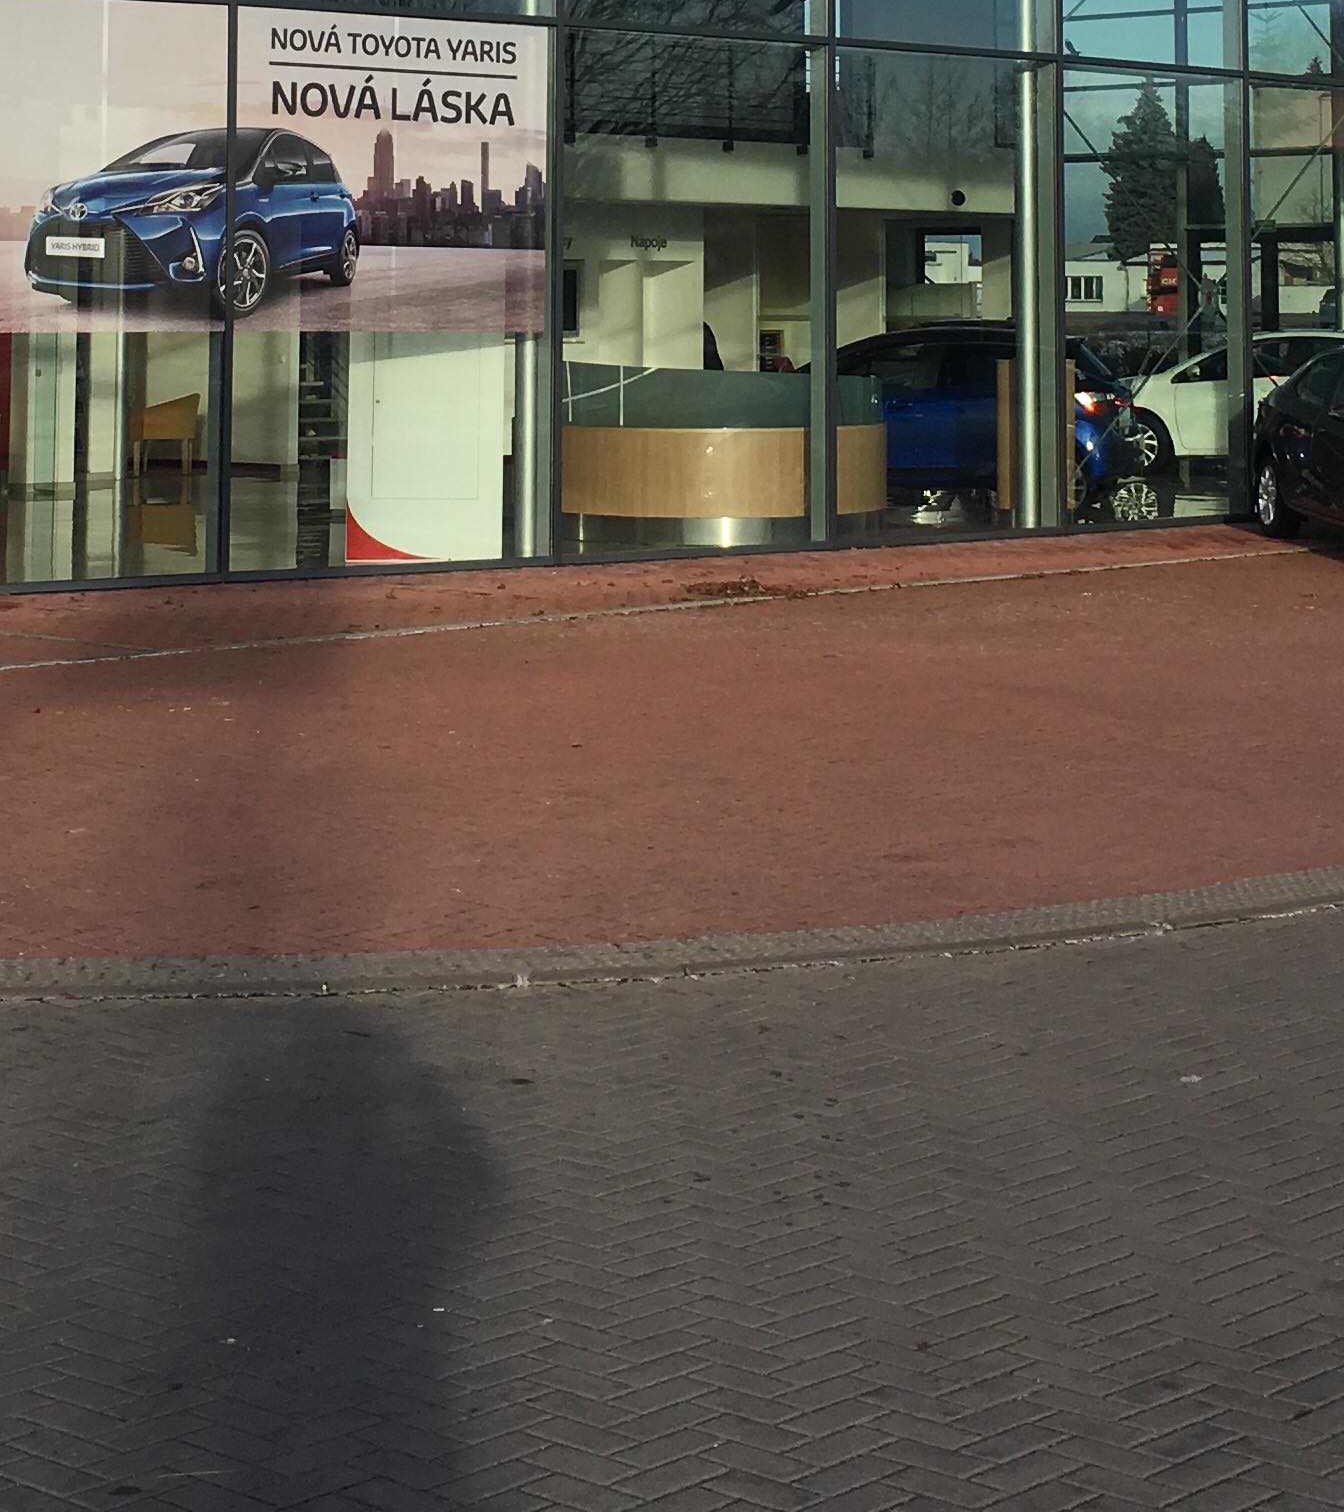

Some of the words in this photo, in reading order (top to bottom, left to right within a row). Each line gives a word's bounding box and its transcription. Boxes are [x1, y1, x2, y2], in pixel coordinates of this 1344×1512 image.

[270, 24, 342, 54] NOVÁ
[347, 32, 441, 61] TOYOTA
[446, 38, 517, 65] YARIS
[271, 74, 382, 121] NOVÁ
[391, 77, 516, 127] LÁSKA
